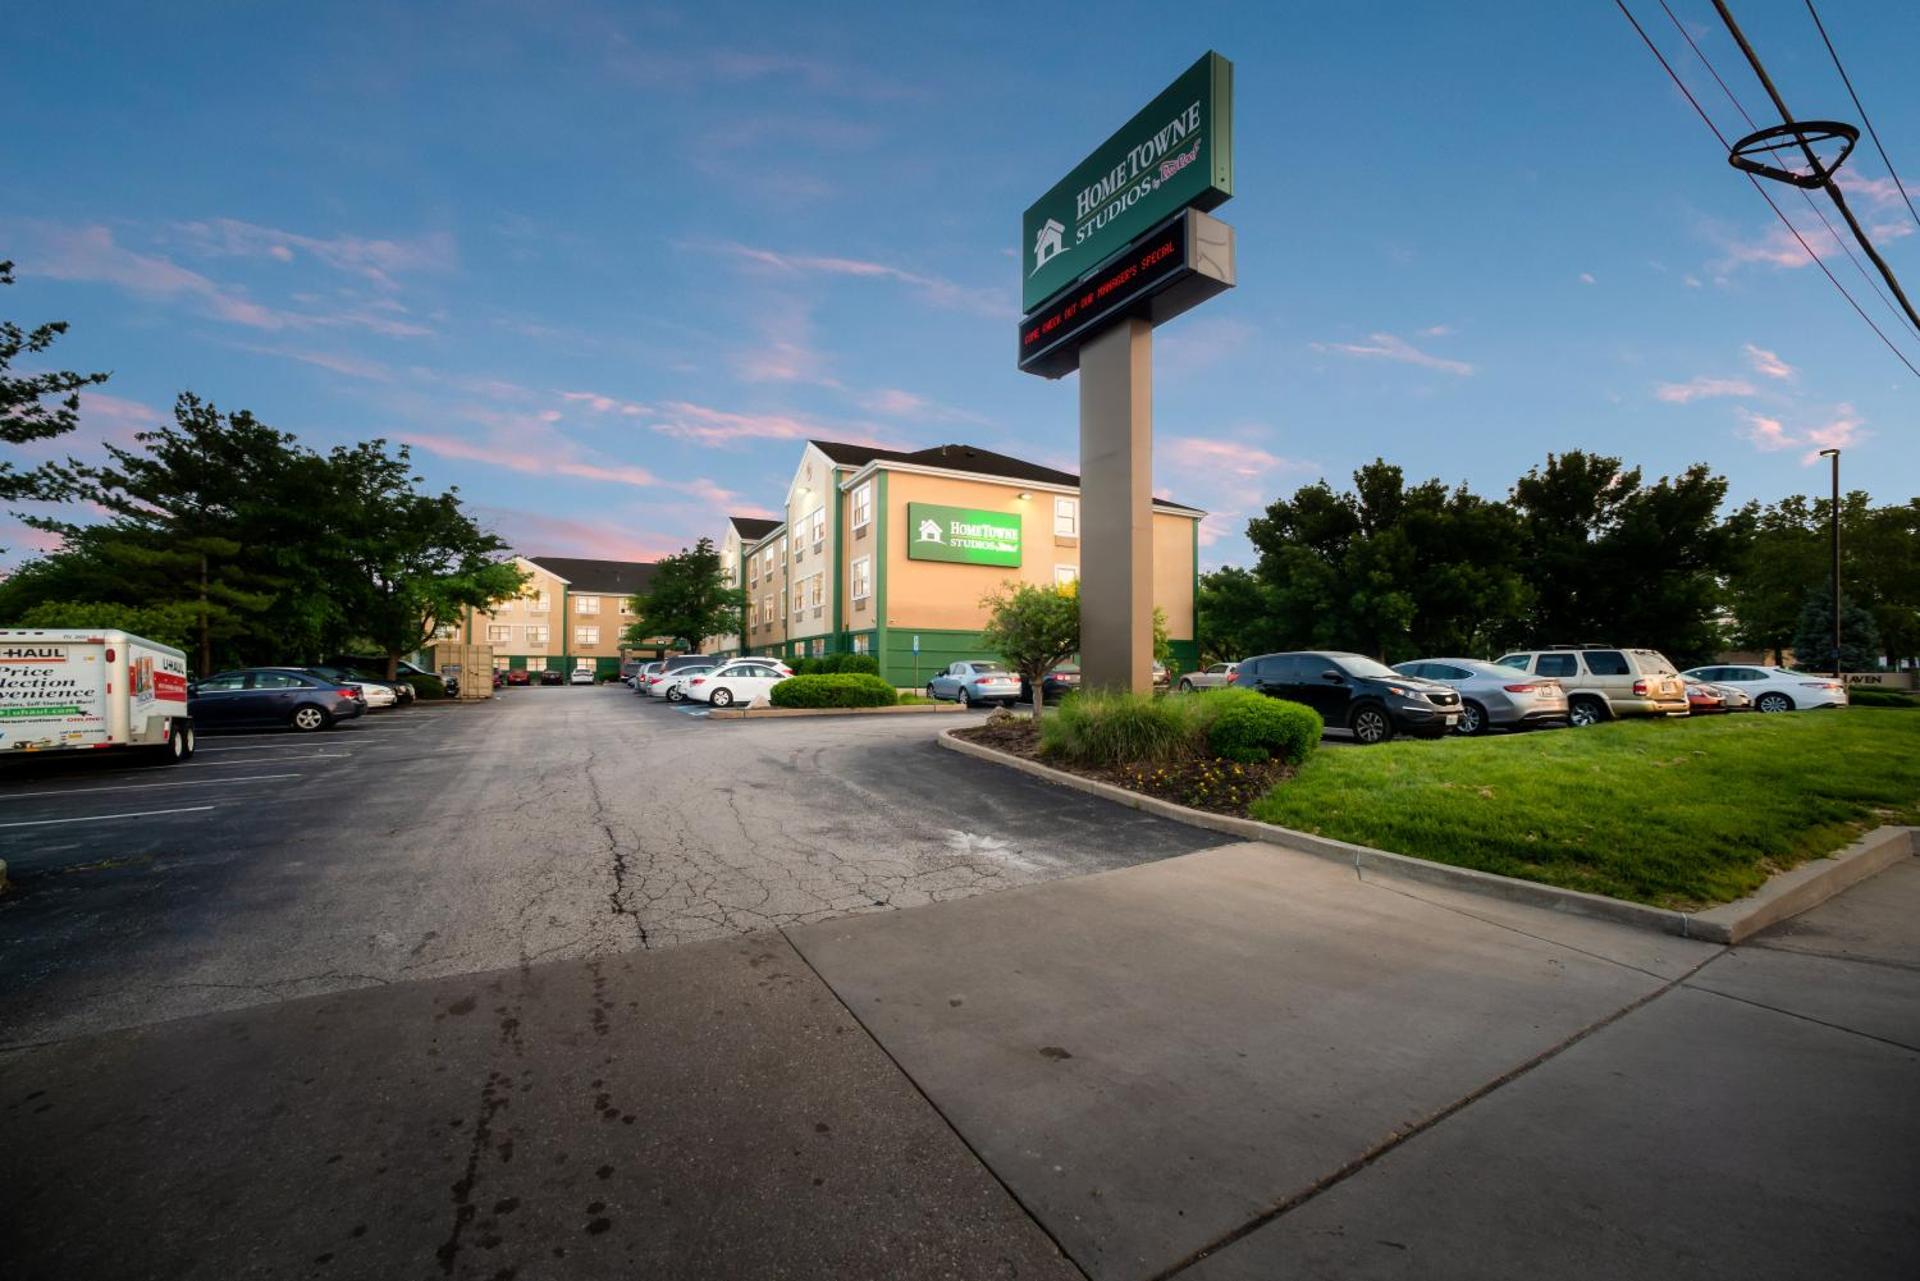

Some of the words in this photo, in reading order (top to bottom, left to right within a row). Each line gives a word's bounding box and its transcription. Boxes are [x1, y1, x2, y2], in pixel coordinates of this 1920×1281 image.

[1076, 176, 1152, 245] STUDIOS
[1024, 328, 1040, 345] COME
[1041, 314, 1062, 333] CHECK
[1064, 303, 1078, 320] OUT
[1079, 292, 1095, 309] OUR
[1097, 265, 1137, 297] MANAGER'S
[1140, 240, 1175, 270] SPECIAL
